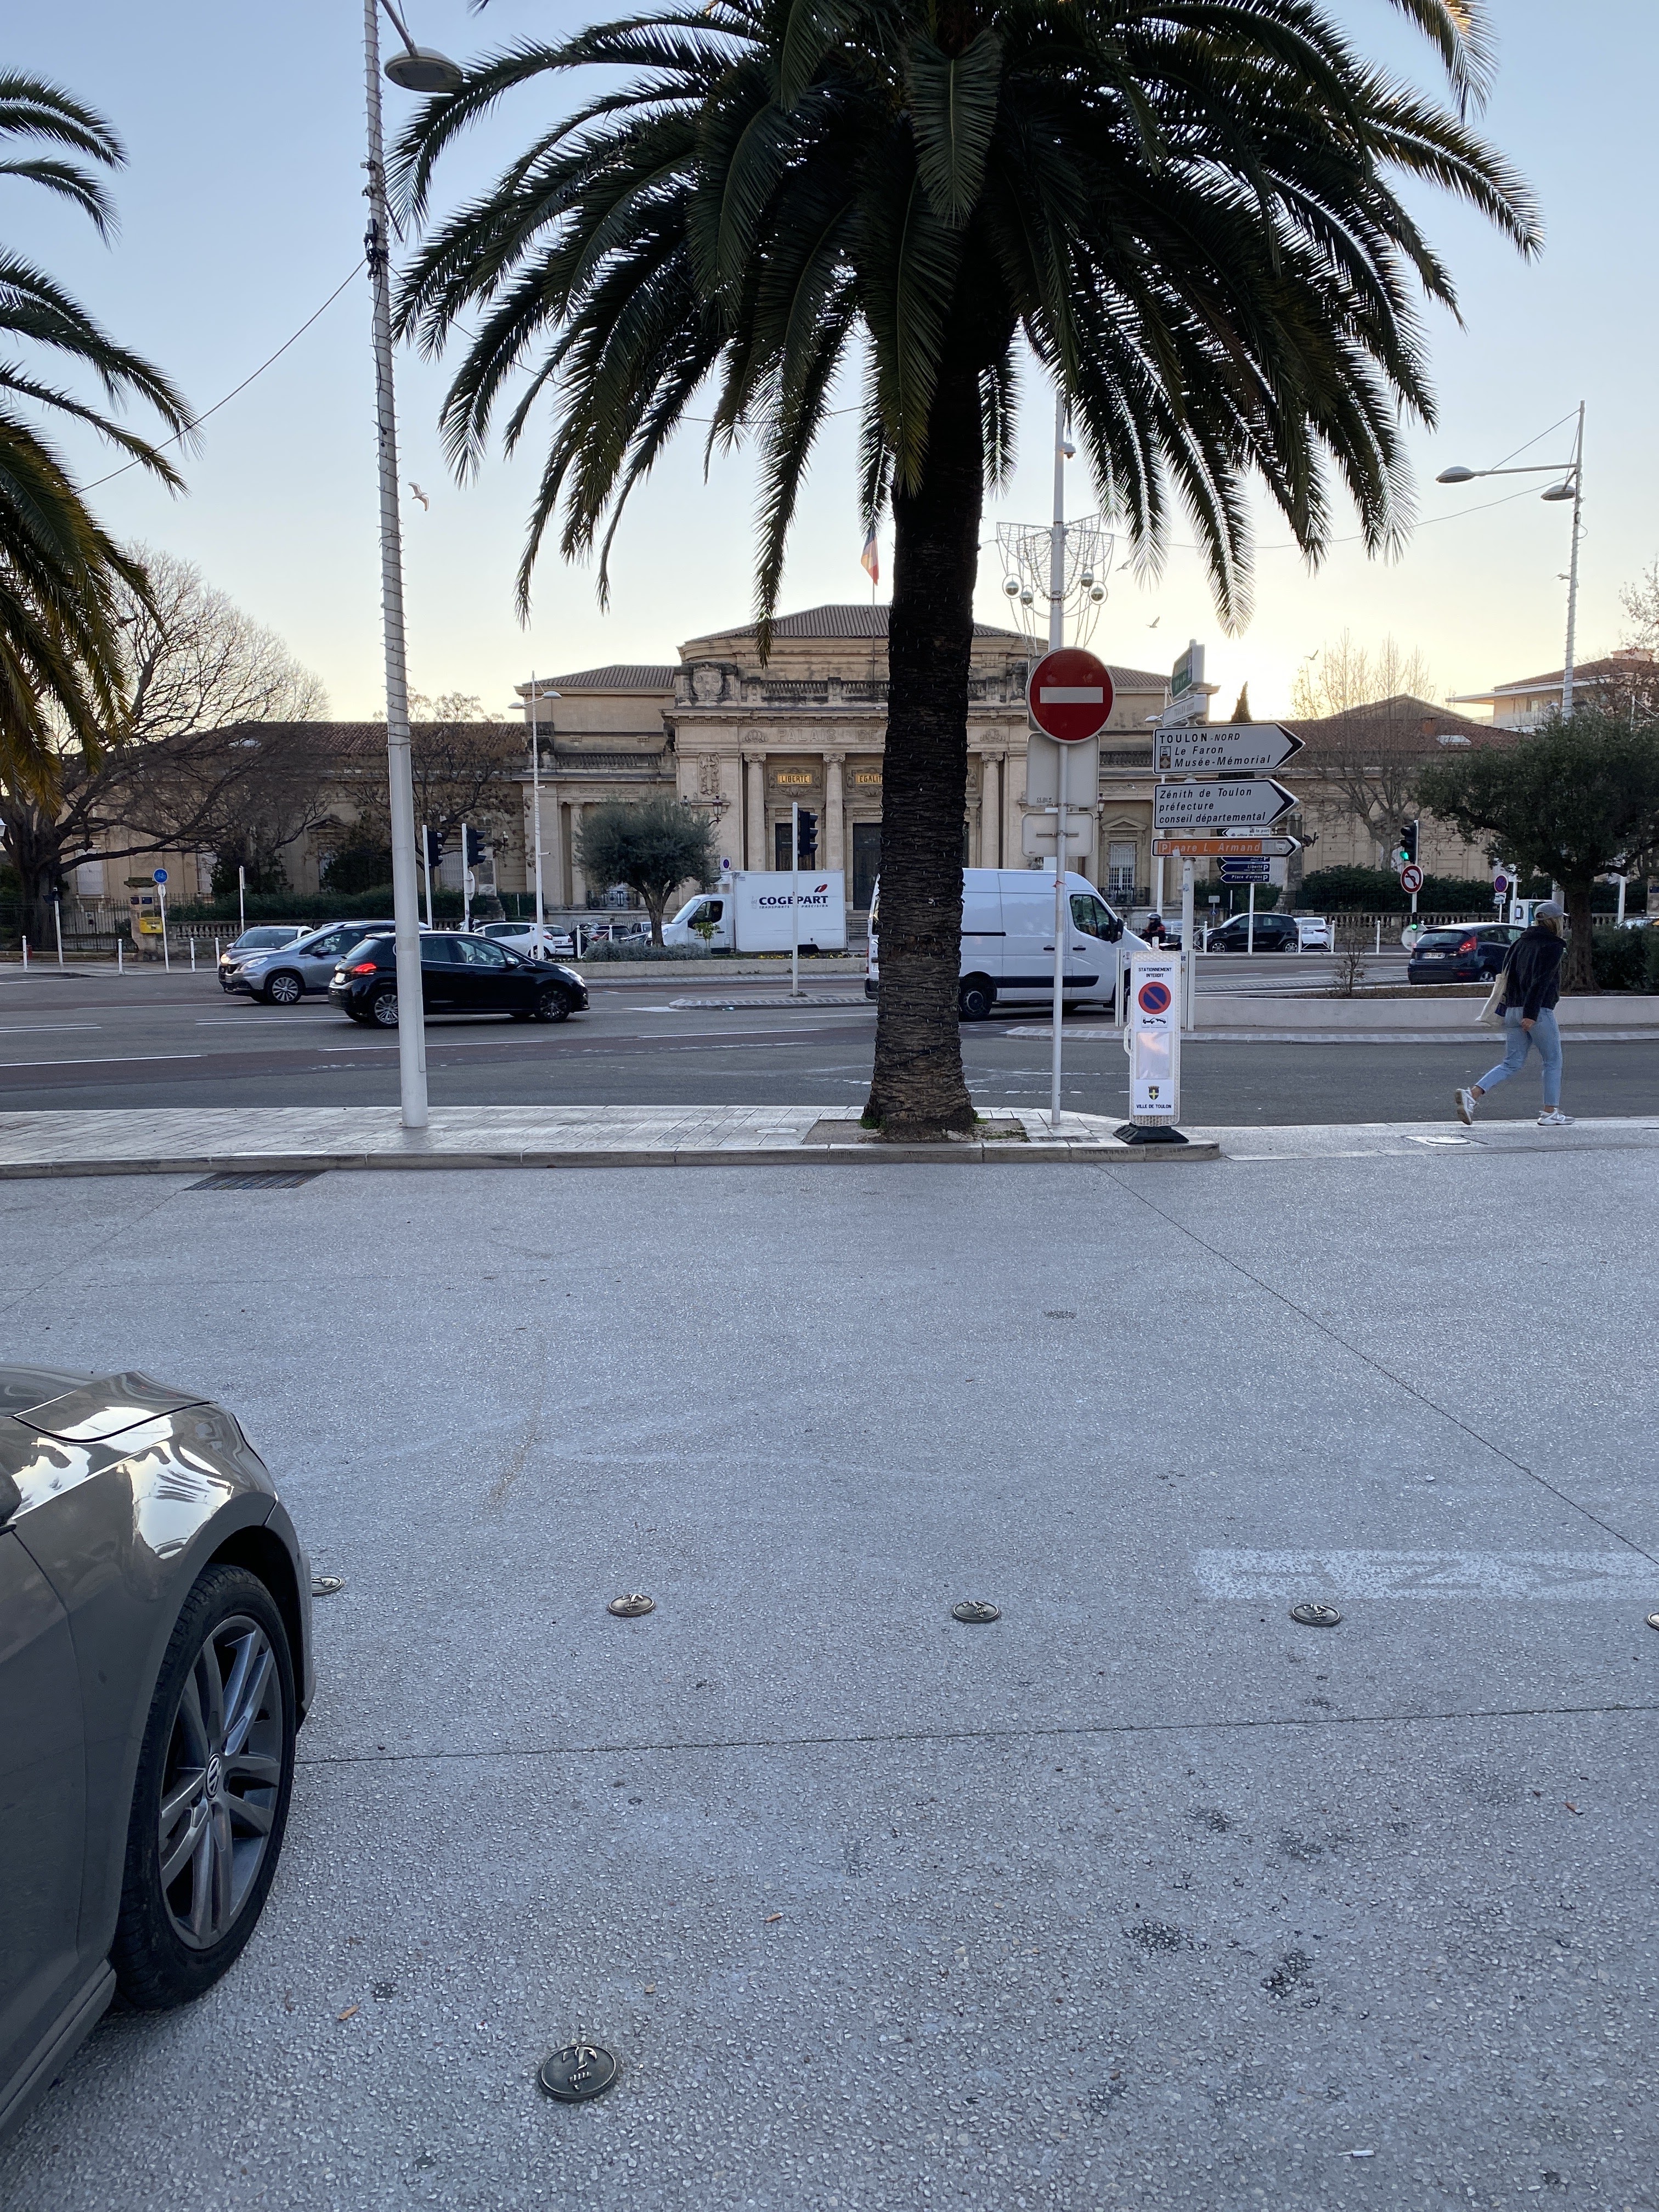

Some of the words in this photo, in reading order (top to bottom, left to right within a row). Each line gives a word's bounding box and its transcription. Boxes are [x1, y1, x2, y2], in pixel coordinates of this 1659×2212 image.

[777, 728, 836, 742] PALAIS
[857, 729, 878, 741] DE
[1159, 733, 1207, 744] TOULON
[1175, 747, 1186, 755] Le
[1192, 746, 1223, 755] Faron
[1174, 754, 1271, 768] Musée-Mémorial
[1159, 789, 1193, 799] Zénith
[1199, 788, 1211, 798] de
[1218, 787, 1252, 797] Toulon
[1159, 802, 1214, 813] préfecture
[1159, 814, 1193, 823] conseil
[1196, 811, 1266, 825] départemental
[1204, 841, 1211, 852] L.
[1217, 842, 1261, 852] Armand
[759, 895, 828, 905] COGEPART
